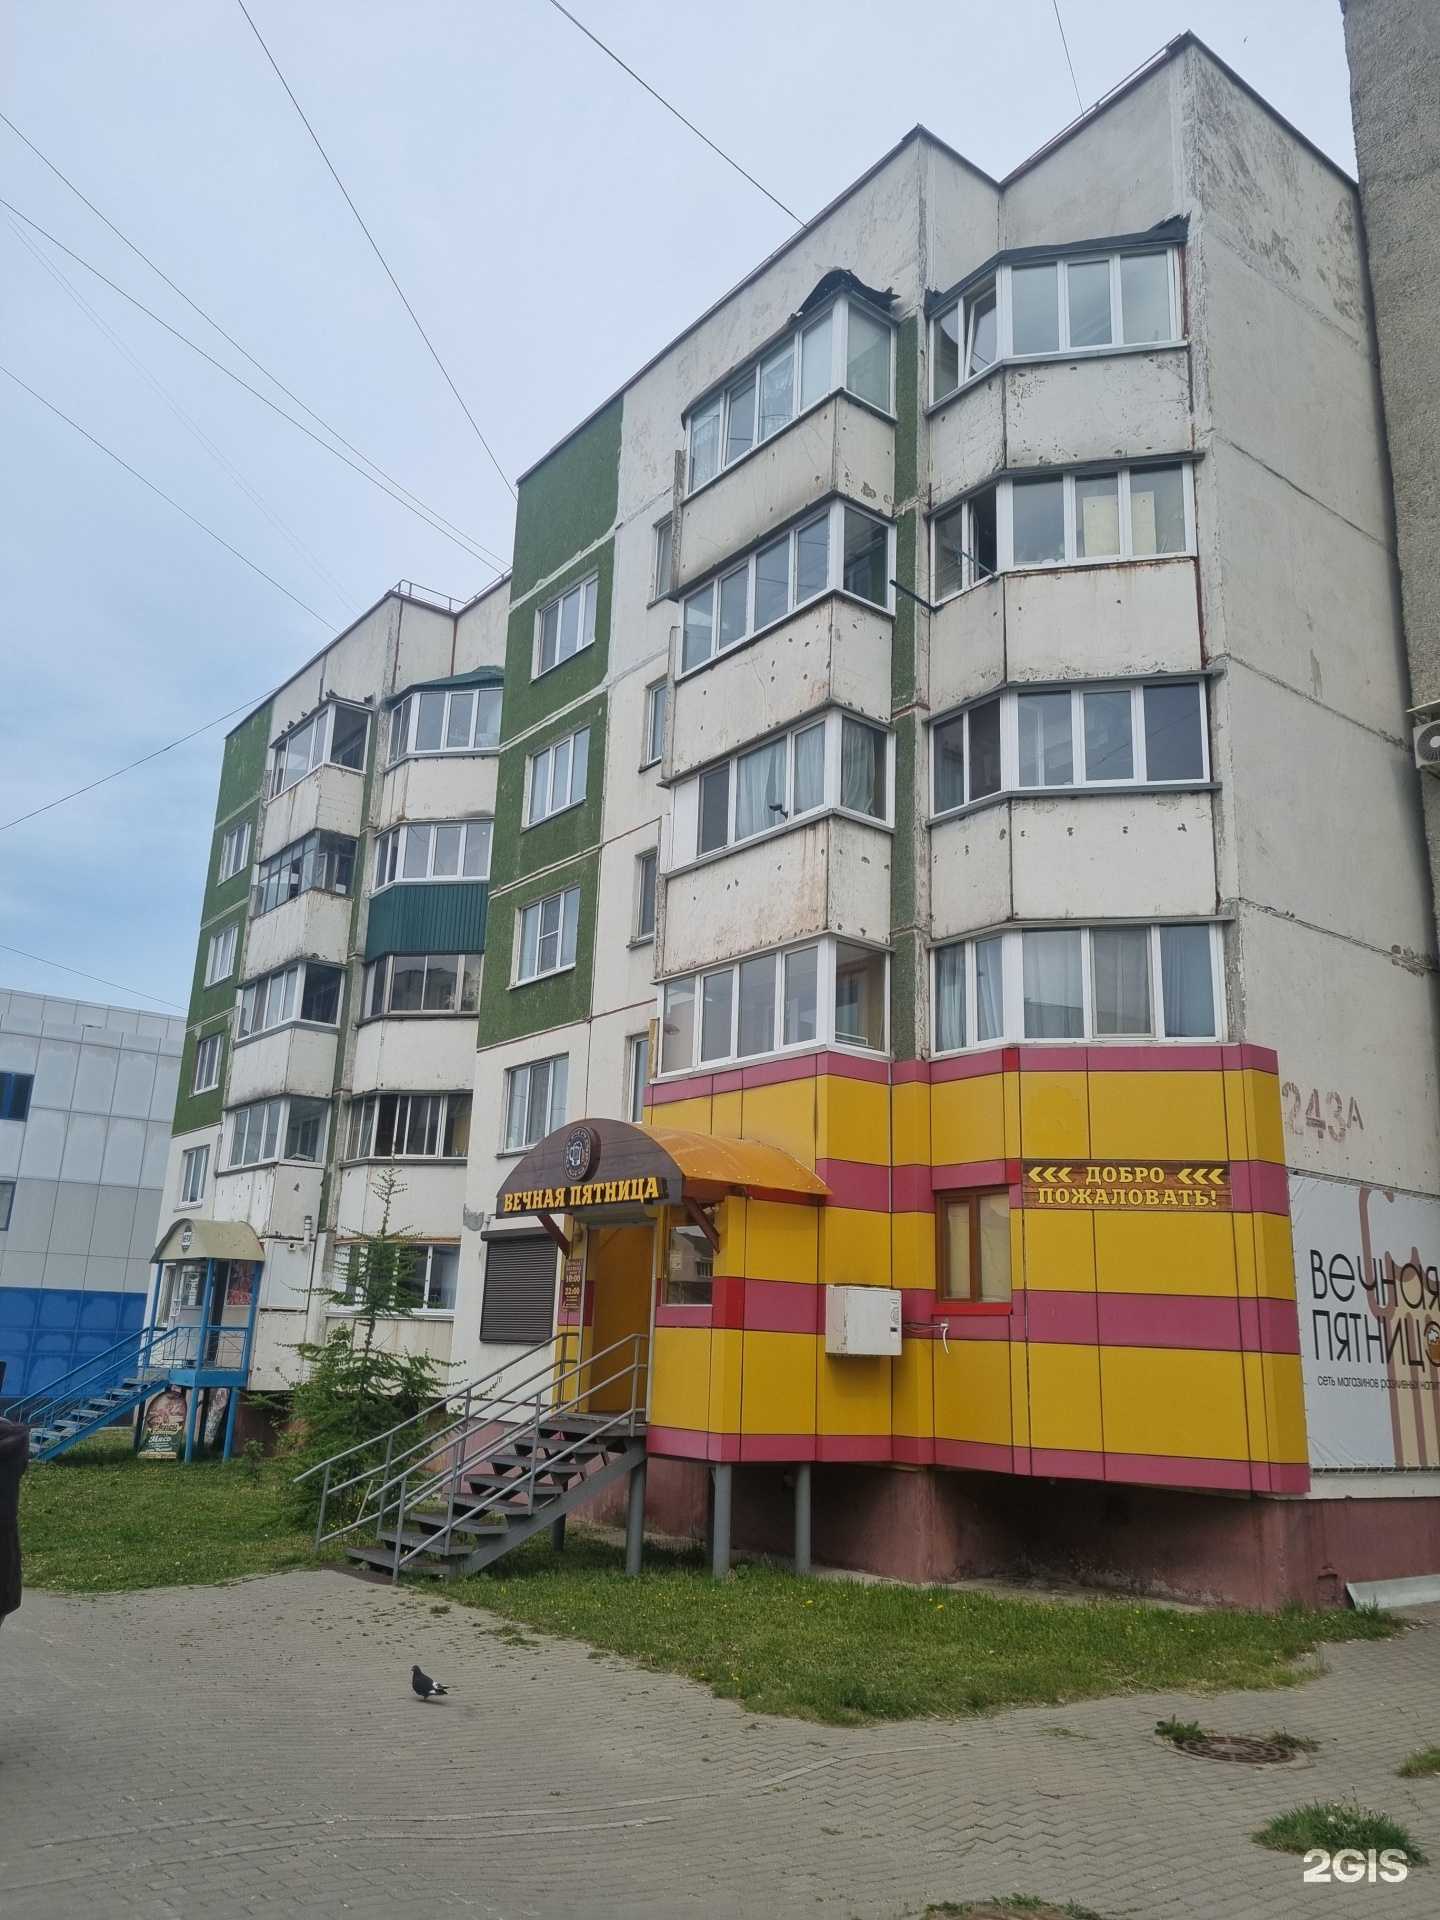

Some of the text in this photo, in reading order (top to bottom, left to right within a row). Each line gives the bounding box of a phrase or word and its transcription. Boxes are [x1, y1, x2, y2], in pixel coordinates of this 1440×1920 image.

[1085, 1166, 1165, 1185] ДОБРО
[503, 1176, 659, 1213] ВЕЧНАЯ ПЯТНИЦА
[1038, 1187, 1217, 1207] ПОЖАЛОВАТЬ!
